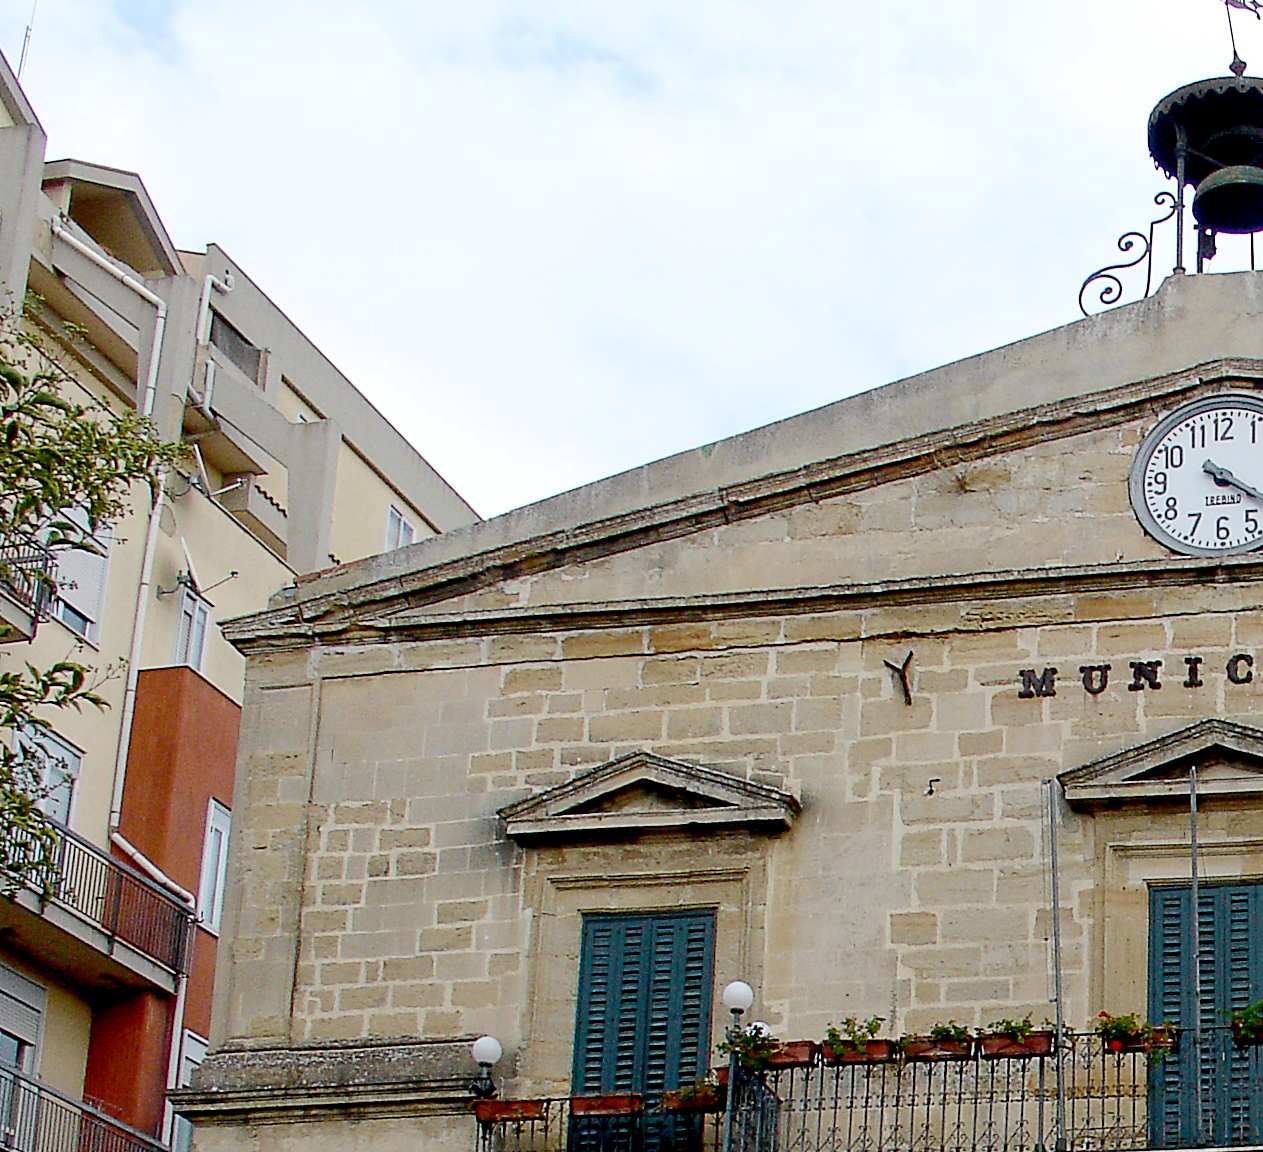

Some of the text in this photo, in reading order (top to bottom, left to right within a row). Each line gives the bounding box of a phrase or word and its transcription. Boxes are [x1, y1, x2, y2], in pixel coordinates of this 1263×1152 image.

[1191, 425, 1205, 448] 11
[1214, 418, 1234, 441] 12
[1251, 420, 1256, 443] 1
[1164, 445, 1183, 469] 10
[1154, 472, 1167, 495] 9
[1165, 497, 1177, 520] 8
[1188, 513, 1202, 536] 7
[1216, 516, 1229, 540] 6
[1245, 509, 1258, 533] 5
